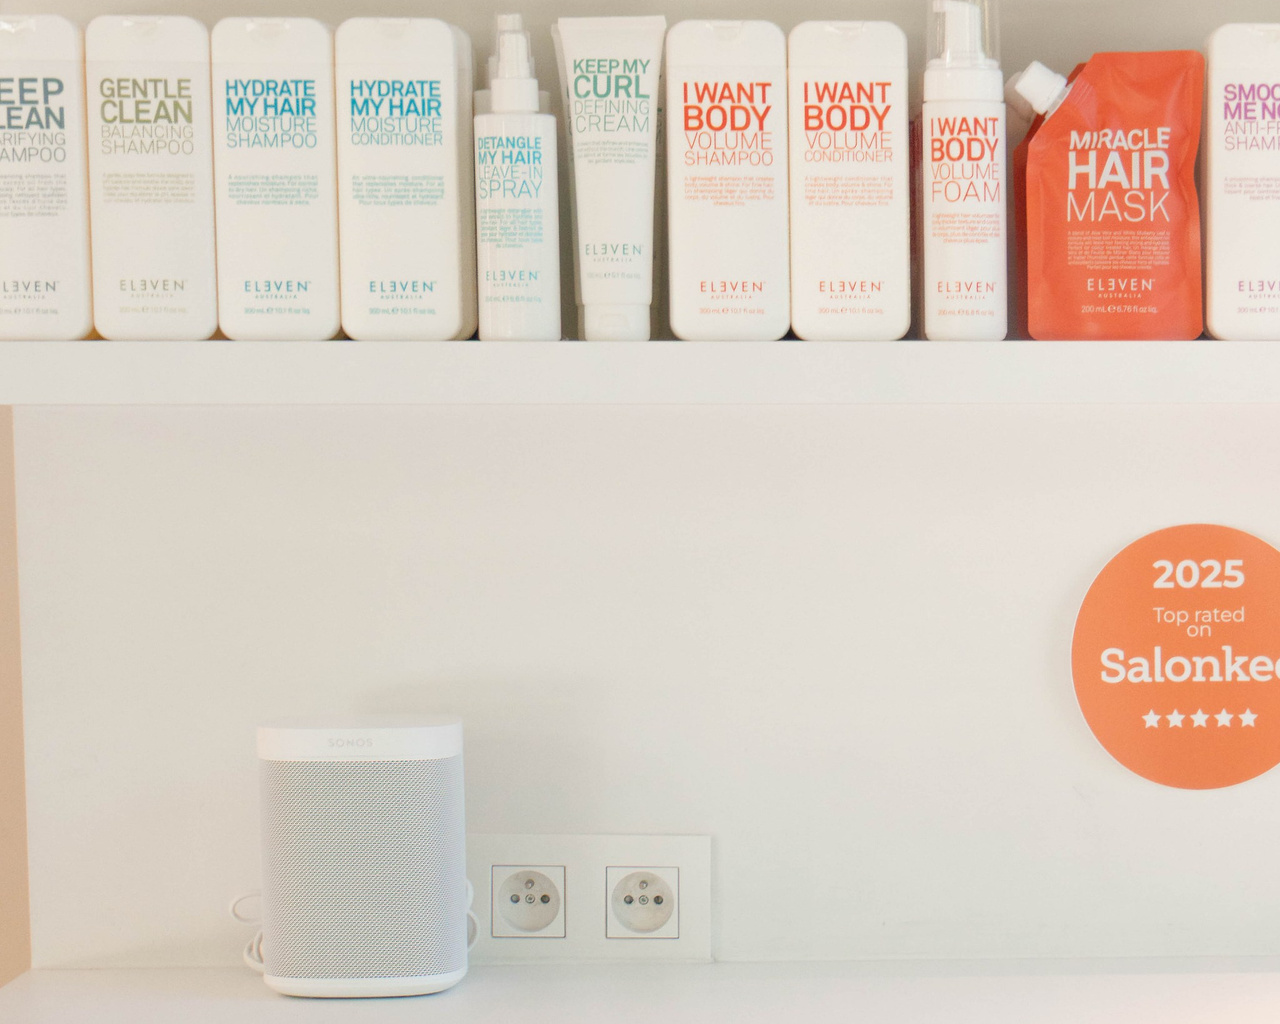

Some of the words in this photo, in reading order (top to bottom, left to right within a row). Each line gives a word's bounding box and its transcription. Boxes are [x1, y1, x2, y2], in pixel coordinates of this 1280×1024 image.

[573, 59, 619, 74] KEEP
[622, 59, 651, 74] MY
[100, 78, 192, 99] GENTLE
[225, 80, 316, 97] HYDRATE
[350, 80, 441, 97] HYDRATE
[573, 75, 651, 99] CURL
[683, 82, 688, 104] I
[694, 82, 772, 104] WANT
[804, 82, 809, 104] I
[814, 82, 892, 104] WANT
[100, 100, 193, 125] CLEAN
[226, 98, 259, 116] MY
[263, 98, 316, 116] HAIR
[350, 98, 383, 116] MY
[388, 98, 442, 116] HAIR
[574, 99, 650, 116] DEFINING
[1224, 102, 1257, 120] ME
[226, 116, 317, 133] MOISTURE
[350, 117, 442, 133] MOISTURE
[575, 116, 650, 134] CREAM
[683, 105, 772, 132] BODY
[804, 105, 892, 132] BODY
[937, 117, 999, 137] WANT
[101, 125, 194, 140] BALANCING
[226, 133, 317, 149] SHAMPOO
[350, 133, 443, 146] CONDITIONER
[684, 132, 773, 150] VOLUME
[805, 132, 893, 150] VOLUME
[1069, 127, 1171, 150] MIRACLE
[101, 139, 194, 156] SHAMPOO
[478, 137, 542, 151] DETANGLE
[930, 138, 999, 162] BODY
[478, 151, 499, 165] MY
[502, 151, 542, 165] HAIR
[684, 150, 774, 167] SHAMPOO
[804, 150, 893, 163] CONDITIONER
[478, 165, 543, 180] LEAVE-IN
[930, 163, 999, 181] VOLUME
[1068, 150, 1170, 190] HAIR
[479, 180, 542, 199] SPRAY
[931, 181, 1000, 203] FOAM
[1067, 191, 1170, 222] MASK
[585, 244, 642, 256] ELEVEN
[244, 281, 309, 293] ELEVEN
[701, 281, 763, 293] ELEVEN
[1087, 279, 1153, 292] ELEVEN
[1152, 559, 1246, 589] 2025
[1153, 607, 1189, 626] Top
[1195, 606, 1245, 623] rated
[1187, 625, 1212, 637] on
[328, 738, 374, 748] SONOS
